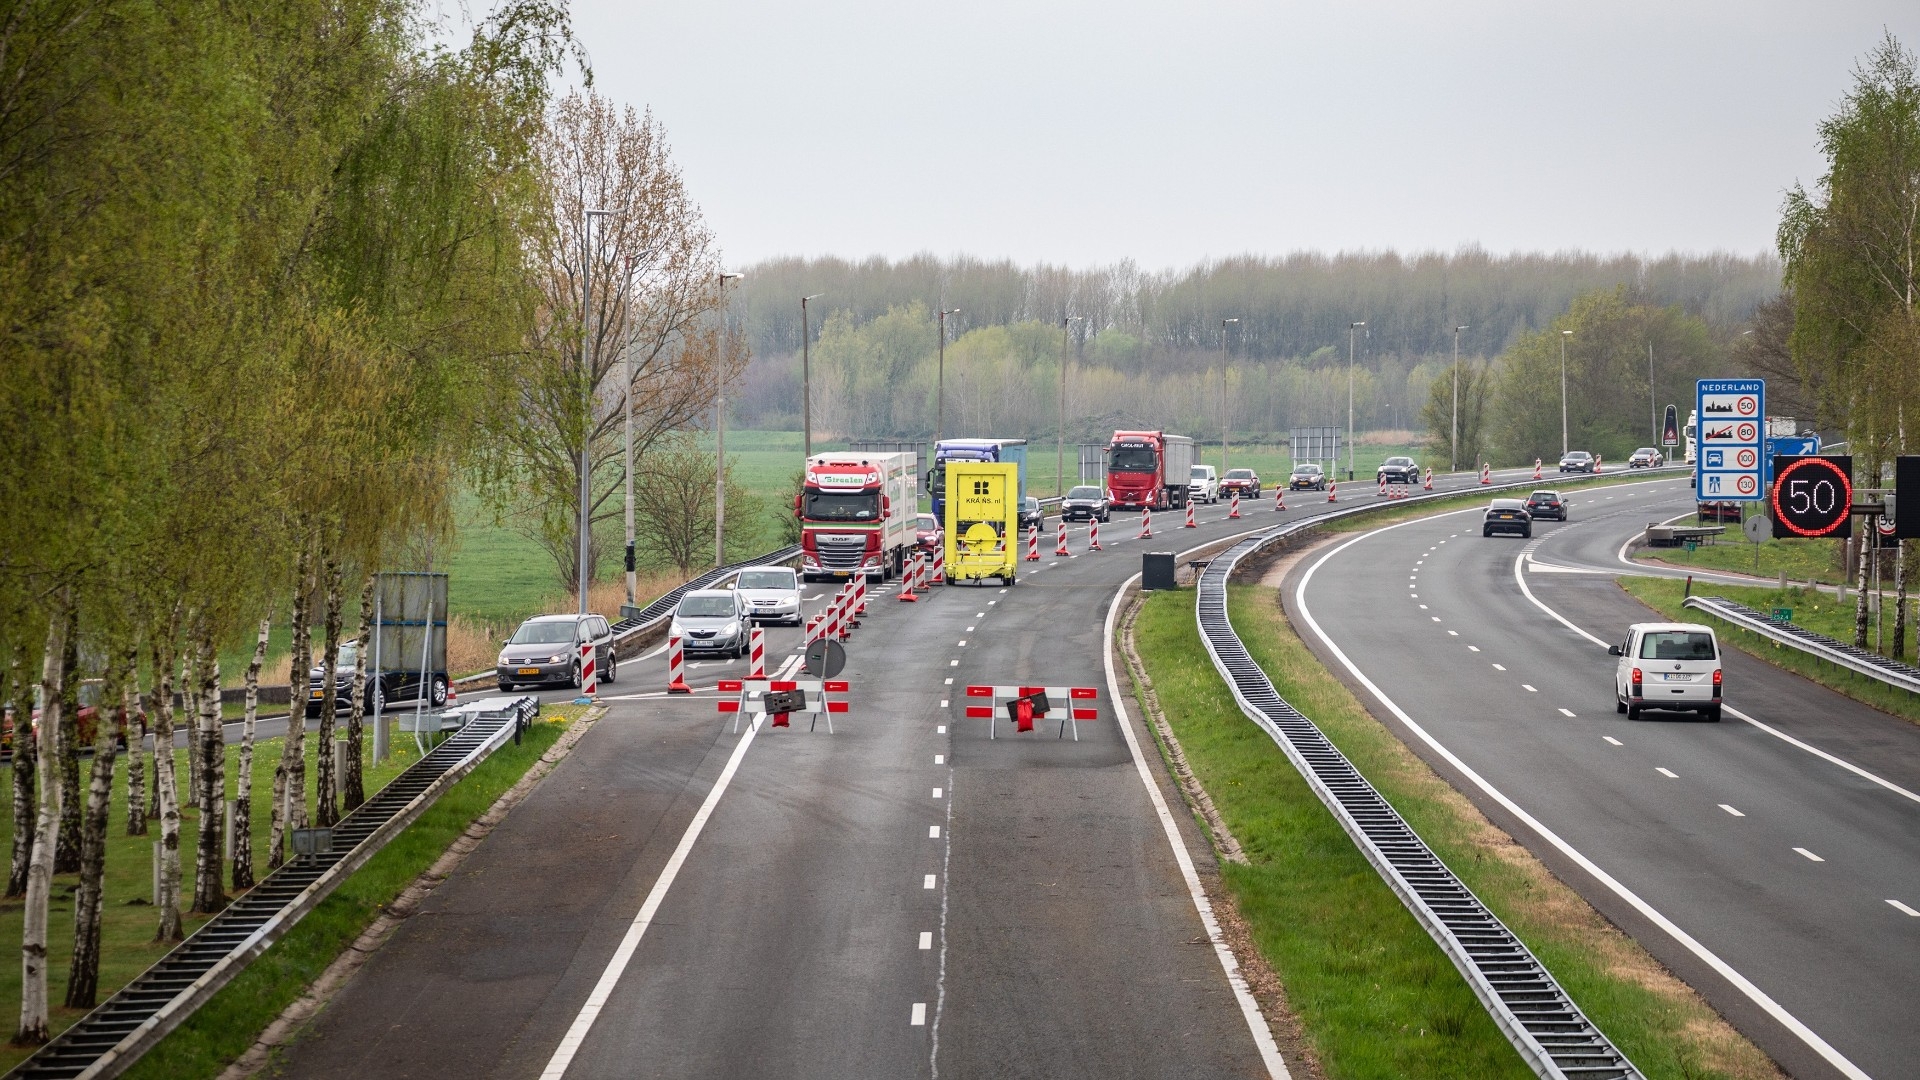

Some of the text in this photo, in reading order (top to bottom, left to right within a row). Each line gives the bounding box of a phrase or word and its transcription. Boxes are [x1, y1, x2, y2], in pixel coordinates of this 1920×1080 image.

[1702, 383, 1760, 392] NEDERLAND
[1740, 402, 1753, 410] 50
[1740, 428, 1753, 436] 80
[1740, 454, 1753, 462] 100
[1740, 481, 1753, 489] 130
[1790, 480, 1835, 514] 50
